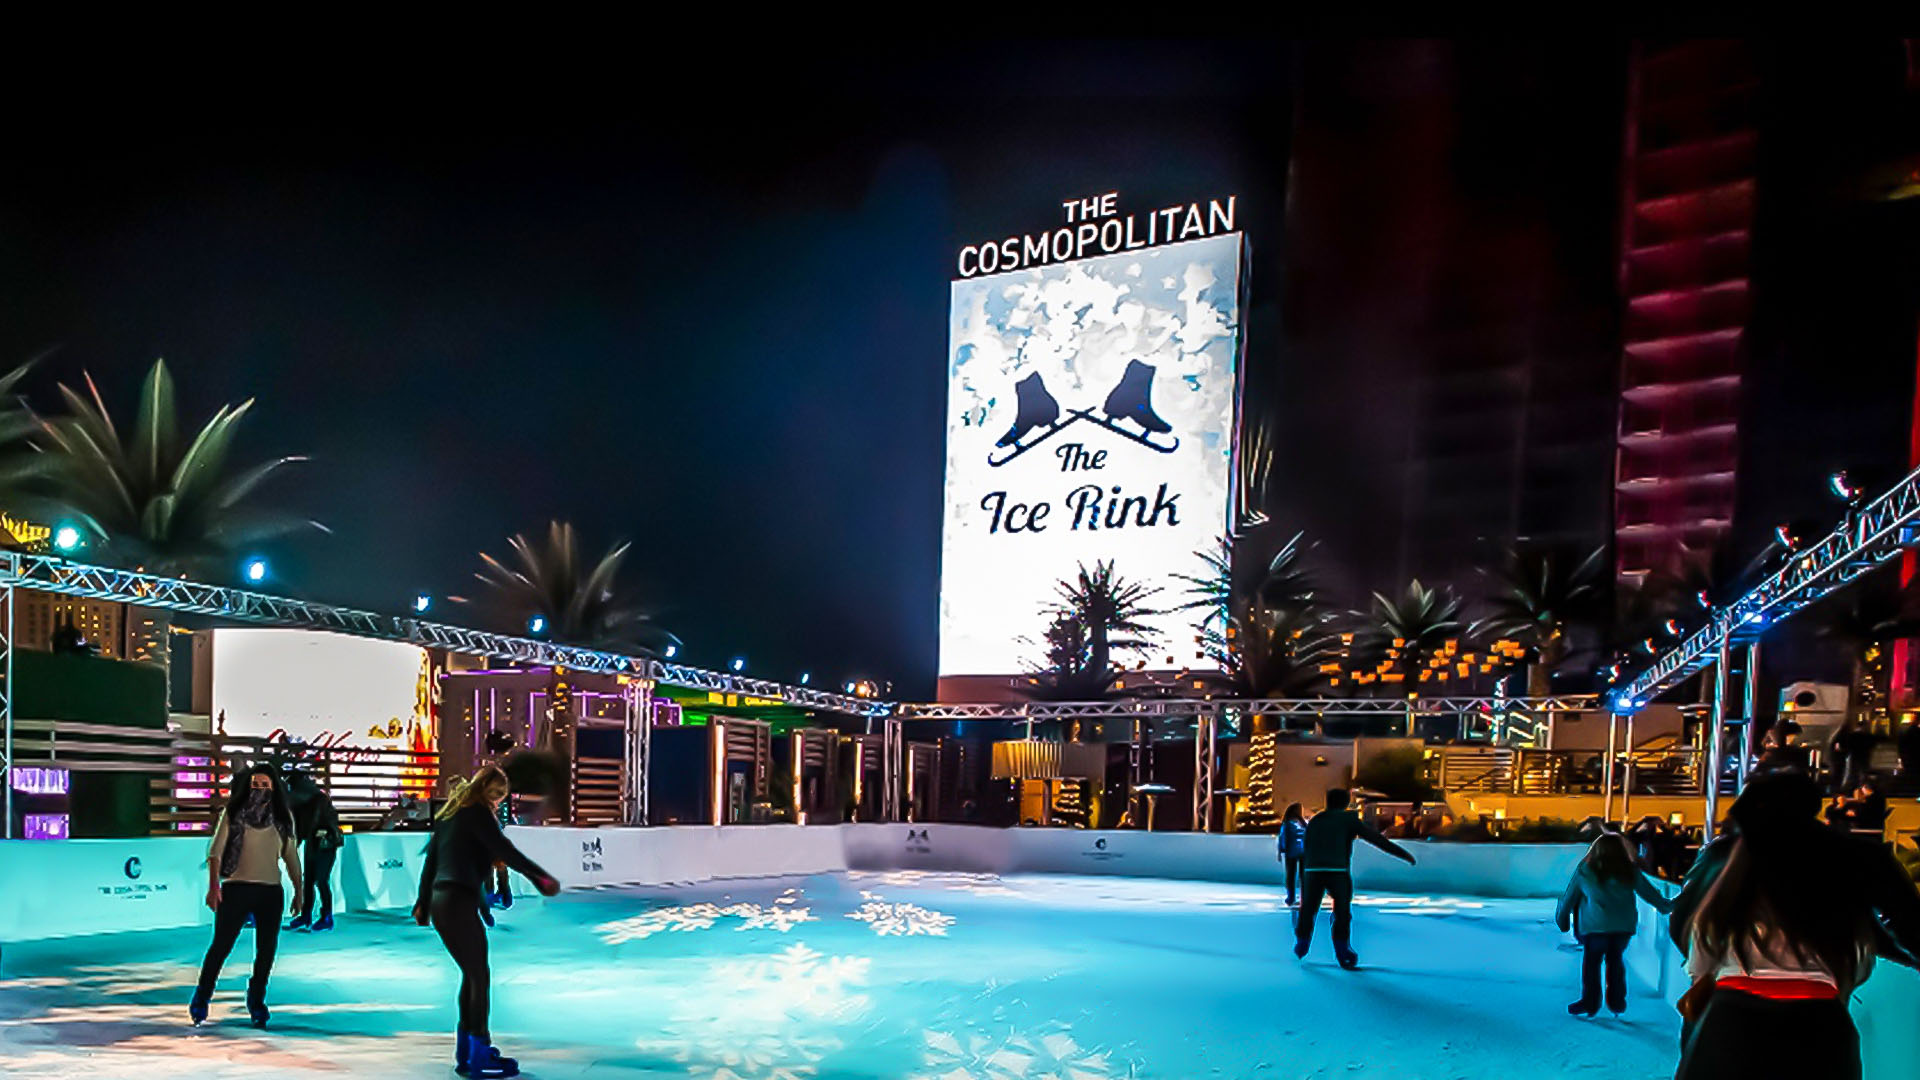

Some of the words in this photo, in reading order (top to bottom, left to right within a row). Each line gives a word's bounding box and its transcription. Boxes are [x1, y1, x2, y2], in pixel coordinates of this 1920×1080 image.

[1062, 192, 1118, 223] THE
[958, 196, 1236, 277] COSMOPOLITAN
[1056, 443, 1108, 472] The
[980, 491, 1050, 535] Ice
[1065, 482, 1182, 532] Rink
